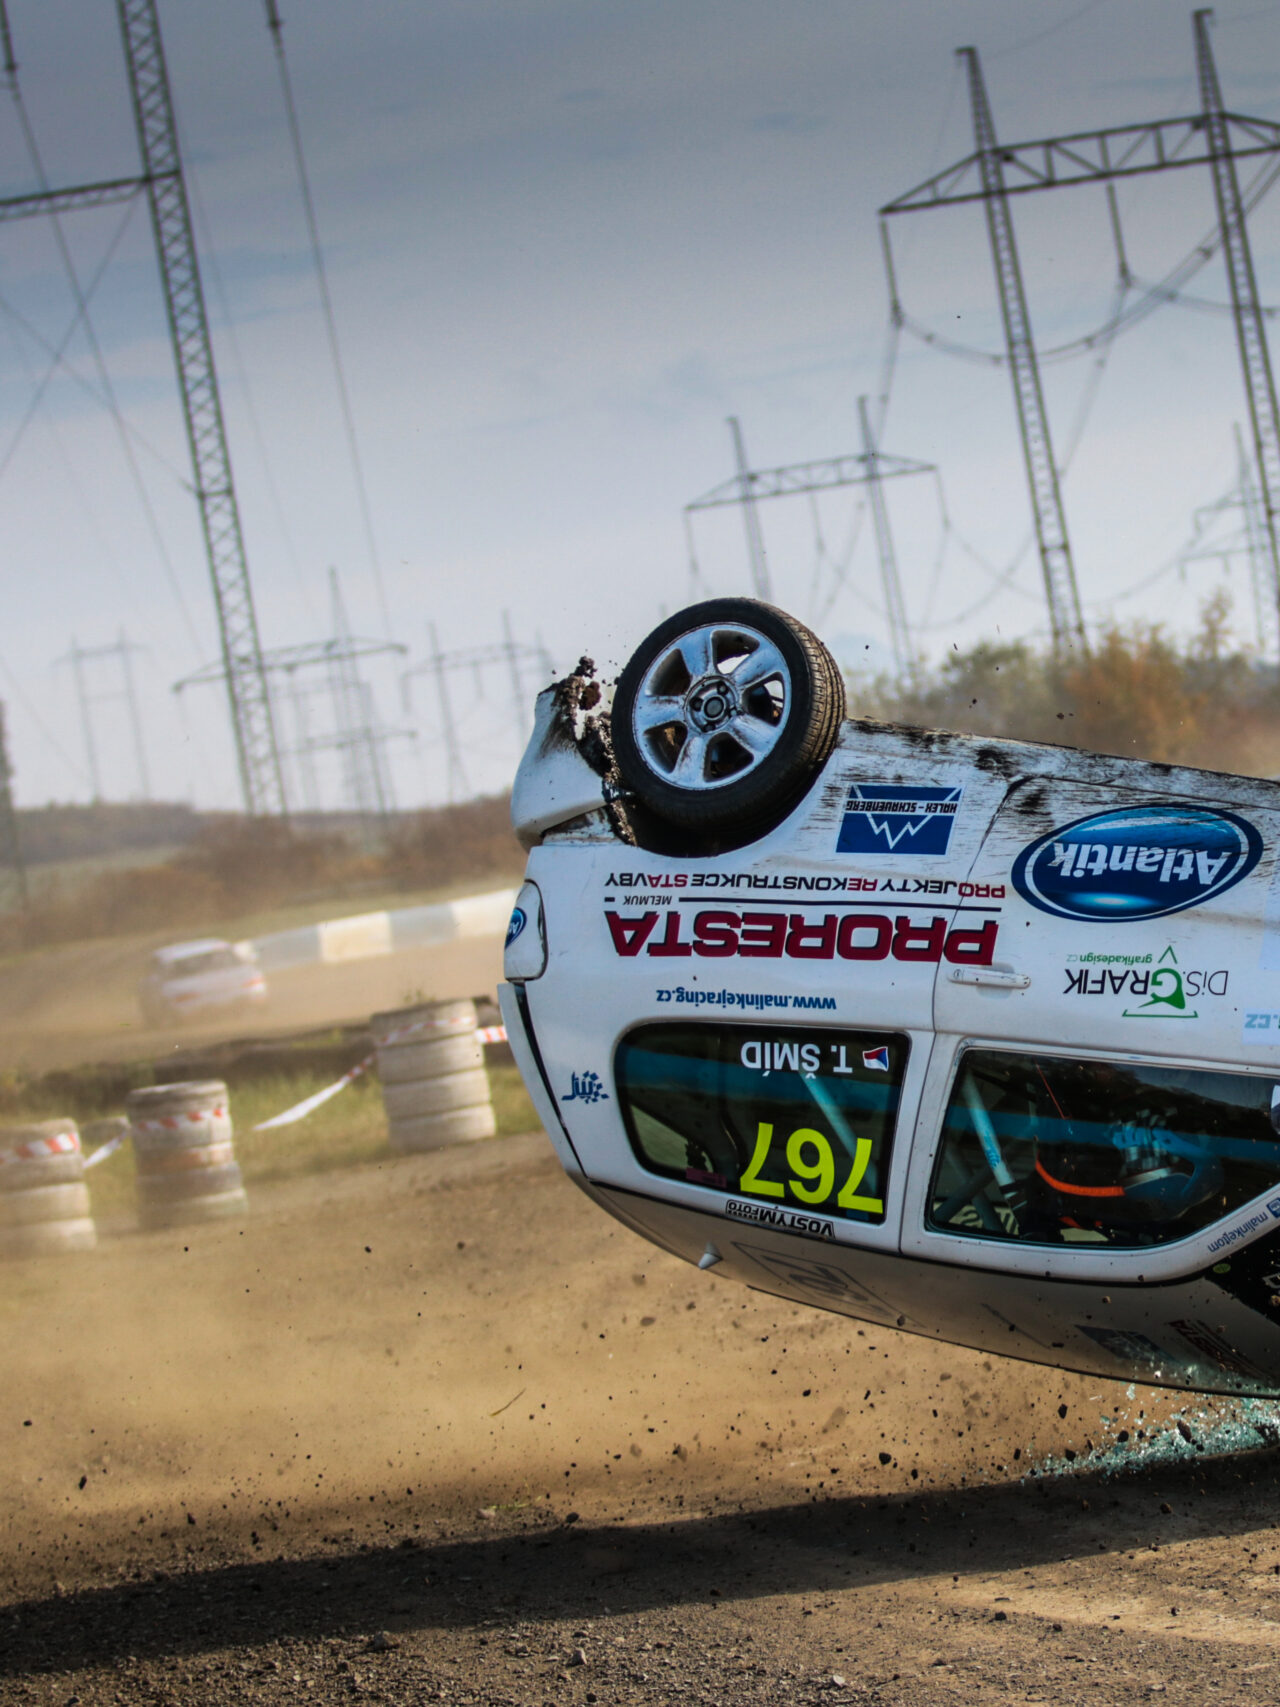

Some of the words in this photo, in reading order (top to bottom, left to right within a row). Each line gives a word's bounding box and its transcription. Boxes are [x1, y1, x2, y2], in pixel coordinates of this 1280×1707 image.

[1047, 840, 1232, 886] Atlantik
[604, 872, 689, 889] STAVBY
[691, 873, 878, 891] REKONSTRUKCE
[878, 878, 1006, 898] PROJEKTY
[622, 894, 672, 906] MELMUK
[604, 910, 999, 966] PRORESTA
[656, 987, 836, 1011] www.malinkejracing.cz
[740, 1040, 821, 1079] ŠMÍD
[831, 1044, 852, 1073] T.
[739, 1121, 884, 1214] 767
[728, 1202, 759, 1216] FOTO
[759, 1208, 833, 1238] VOSTYM
